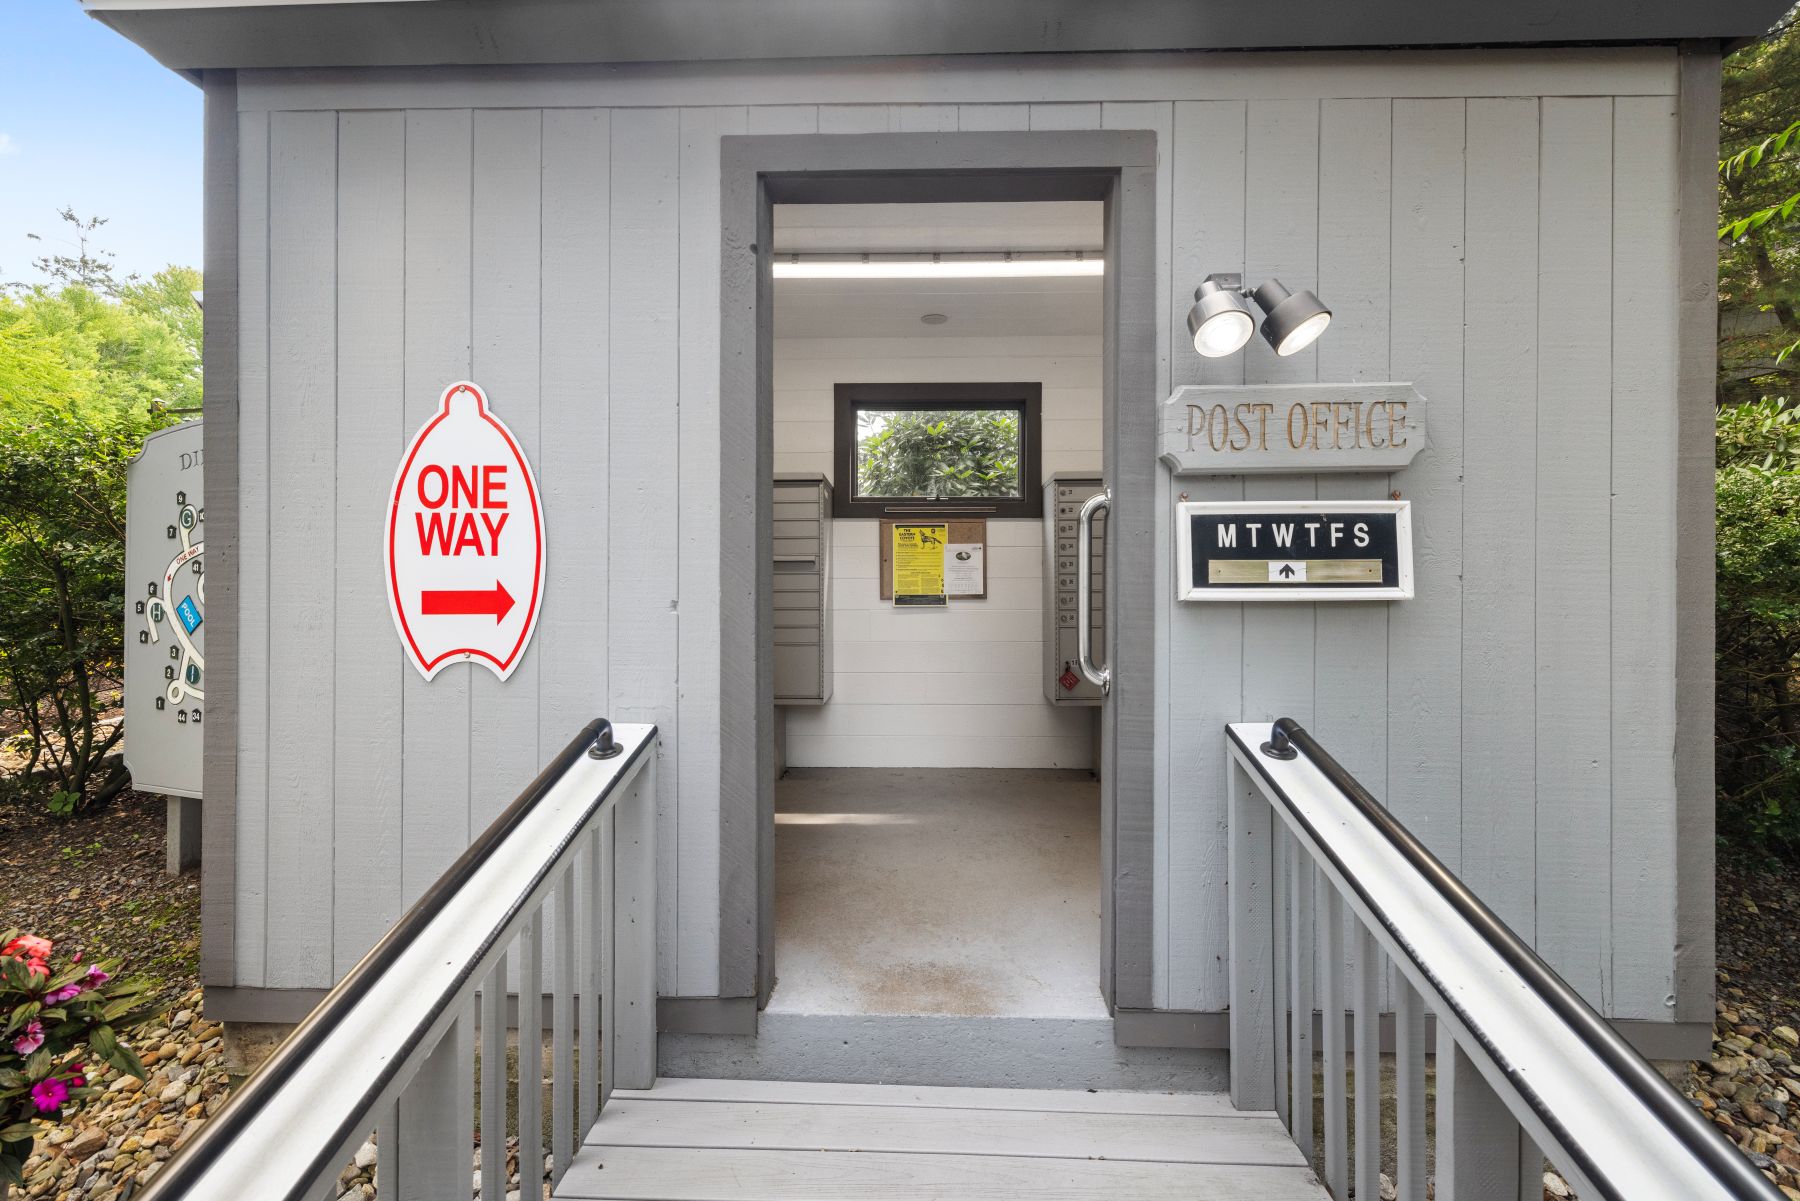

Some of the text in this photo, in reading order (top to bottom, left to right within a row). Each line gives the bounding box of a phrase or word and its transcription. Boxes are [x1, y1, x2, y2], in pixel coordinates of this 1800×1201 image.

[1186, 401, 1408, 451] POST OFFICE
[417, 464, 508, 509] ONE
[182, 510, 192, 527] G
[415, 512, 509, 556] WAY
[176, 546, 199, 564] ONE WAY
[152, 604, 161, 620] H
[181, 602, 196, 627] POOL
